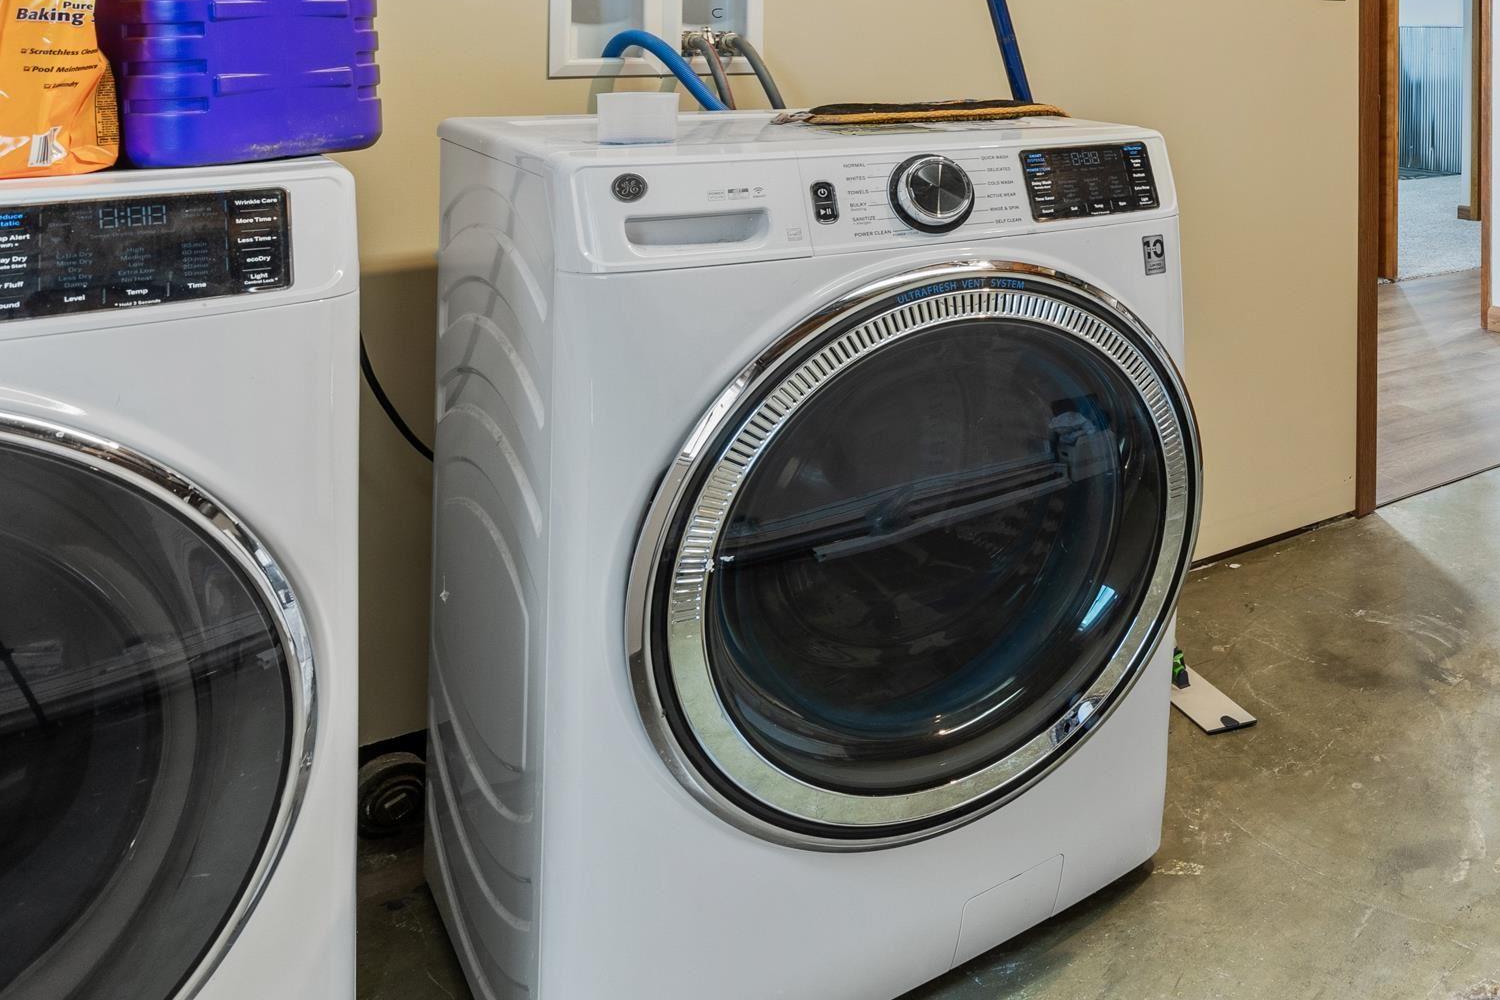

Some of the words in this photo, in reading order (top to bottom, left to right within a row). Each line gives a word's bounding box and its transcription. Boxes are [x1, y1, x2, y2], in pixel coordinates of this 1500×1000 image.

[63, 2, 93, 10] Pure
[16, 8, 84, 26] Baking
[896, 281, 956, 304] ULTRAFRESH
[961, 279, 986, 288] VENT
[990, 279, 1025, 289] SYSTEM
